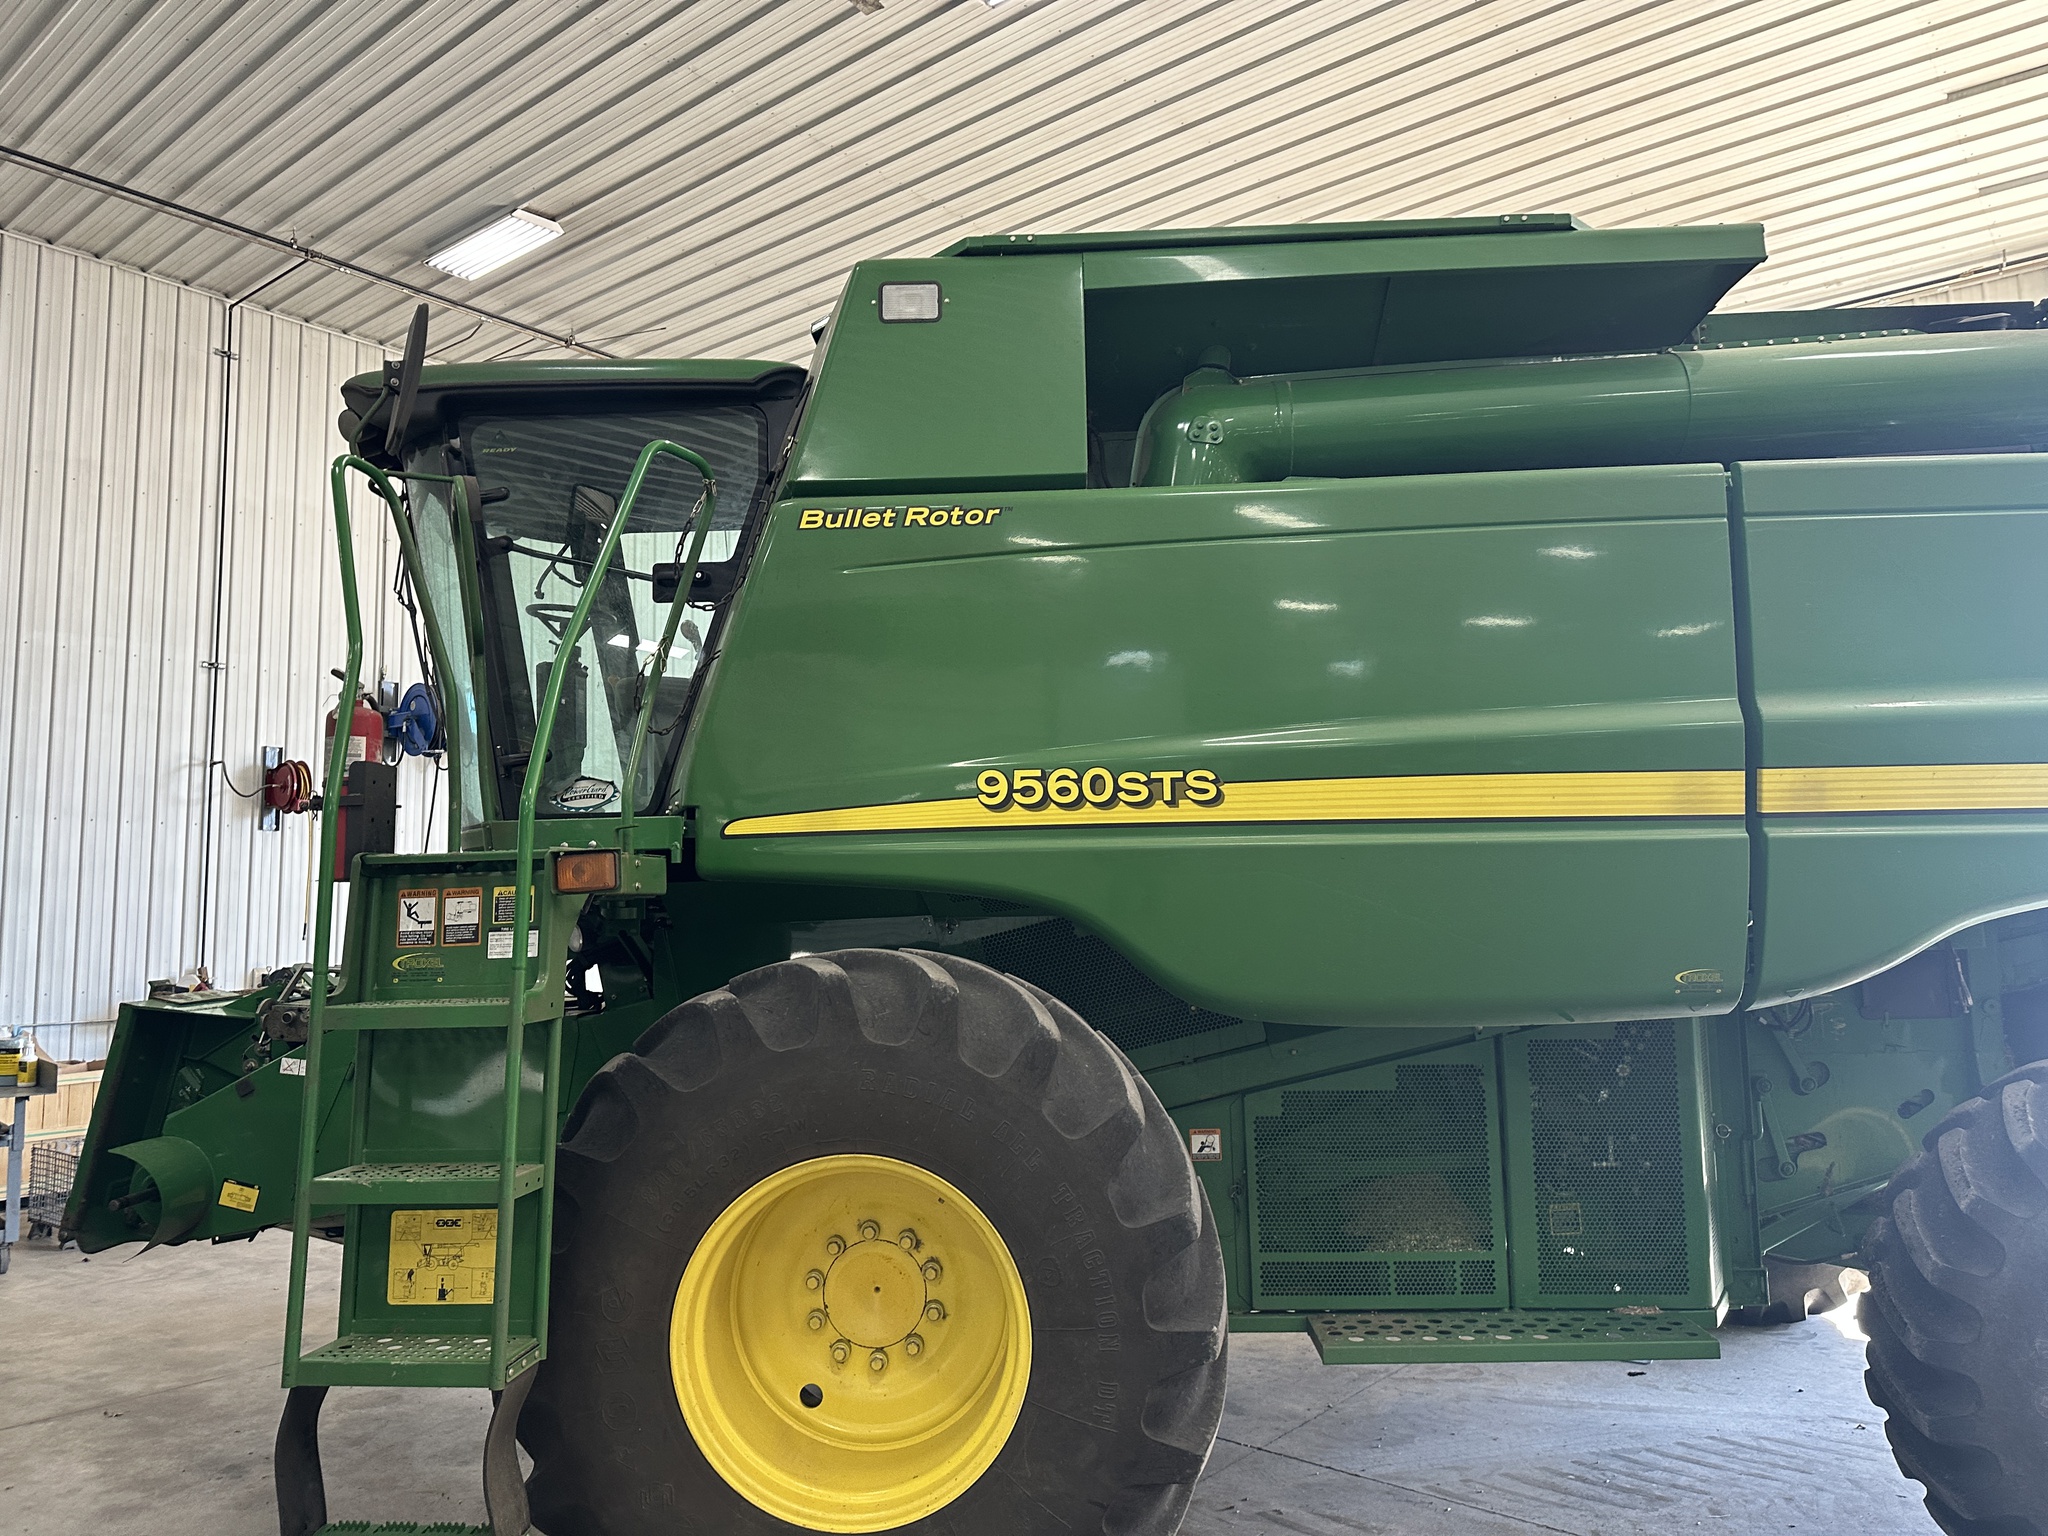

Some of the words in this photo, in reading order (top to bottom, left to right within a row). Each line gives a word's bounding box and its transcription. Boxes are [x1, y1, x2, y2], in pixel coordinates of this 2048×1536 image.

[798, 507, 898, 530] Bullet
[901, 505, 1002, 529] Rotor
[975, 765, 1225, 813] 9560STS
